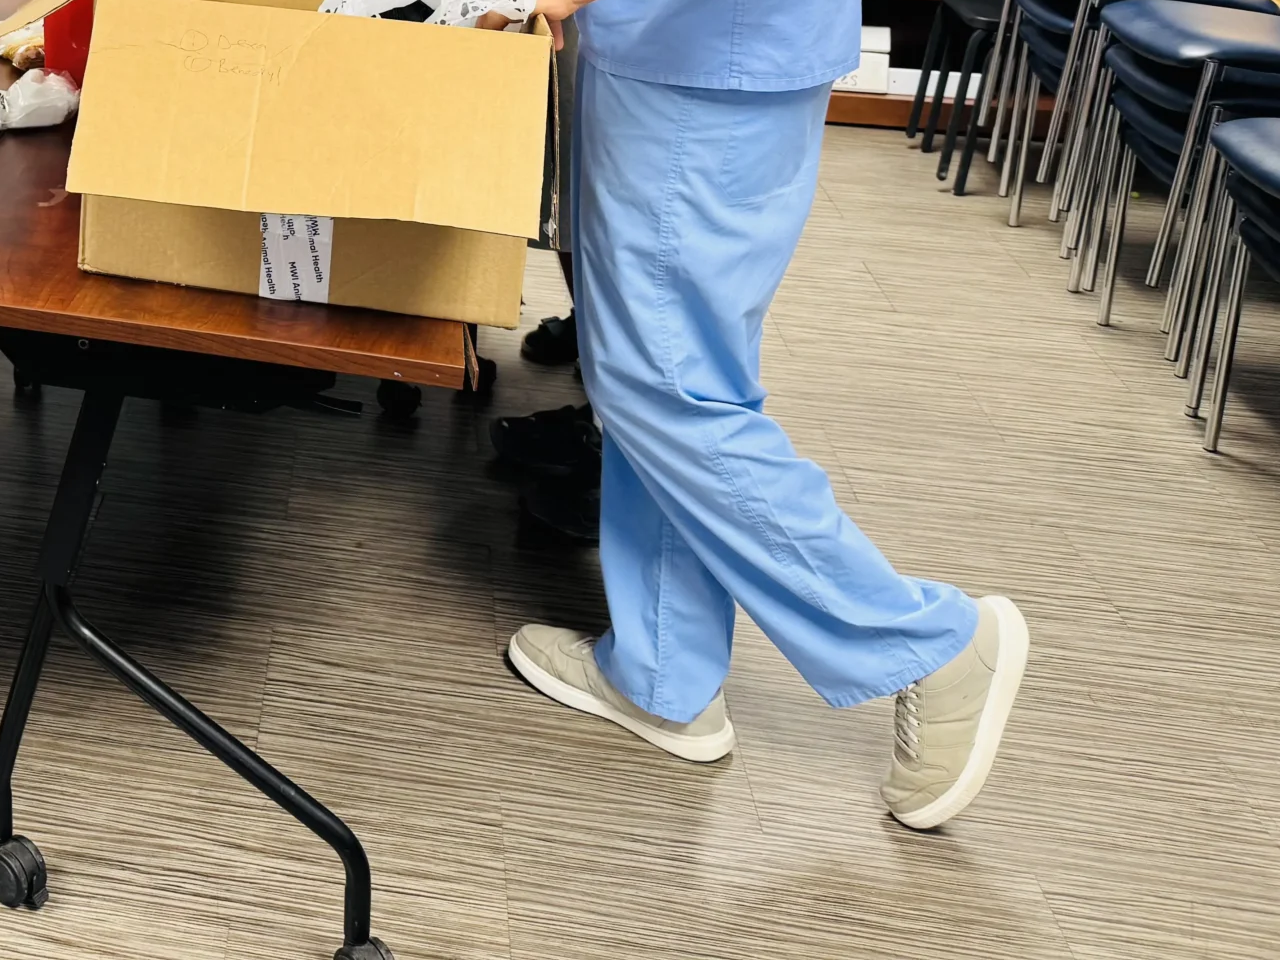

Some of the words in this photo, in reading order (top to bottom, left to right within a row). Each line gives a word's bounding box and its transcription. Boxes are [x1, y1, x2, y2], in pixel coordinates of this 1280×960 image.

[305, 224, 319, 253] Animal
[264, 267, 276, 294] Health
[288, 261, 298, 280] MWI
[311, 254, 323, 283] Health
